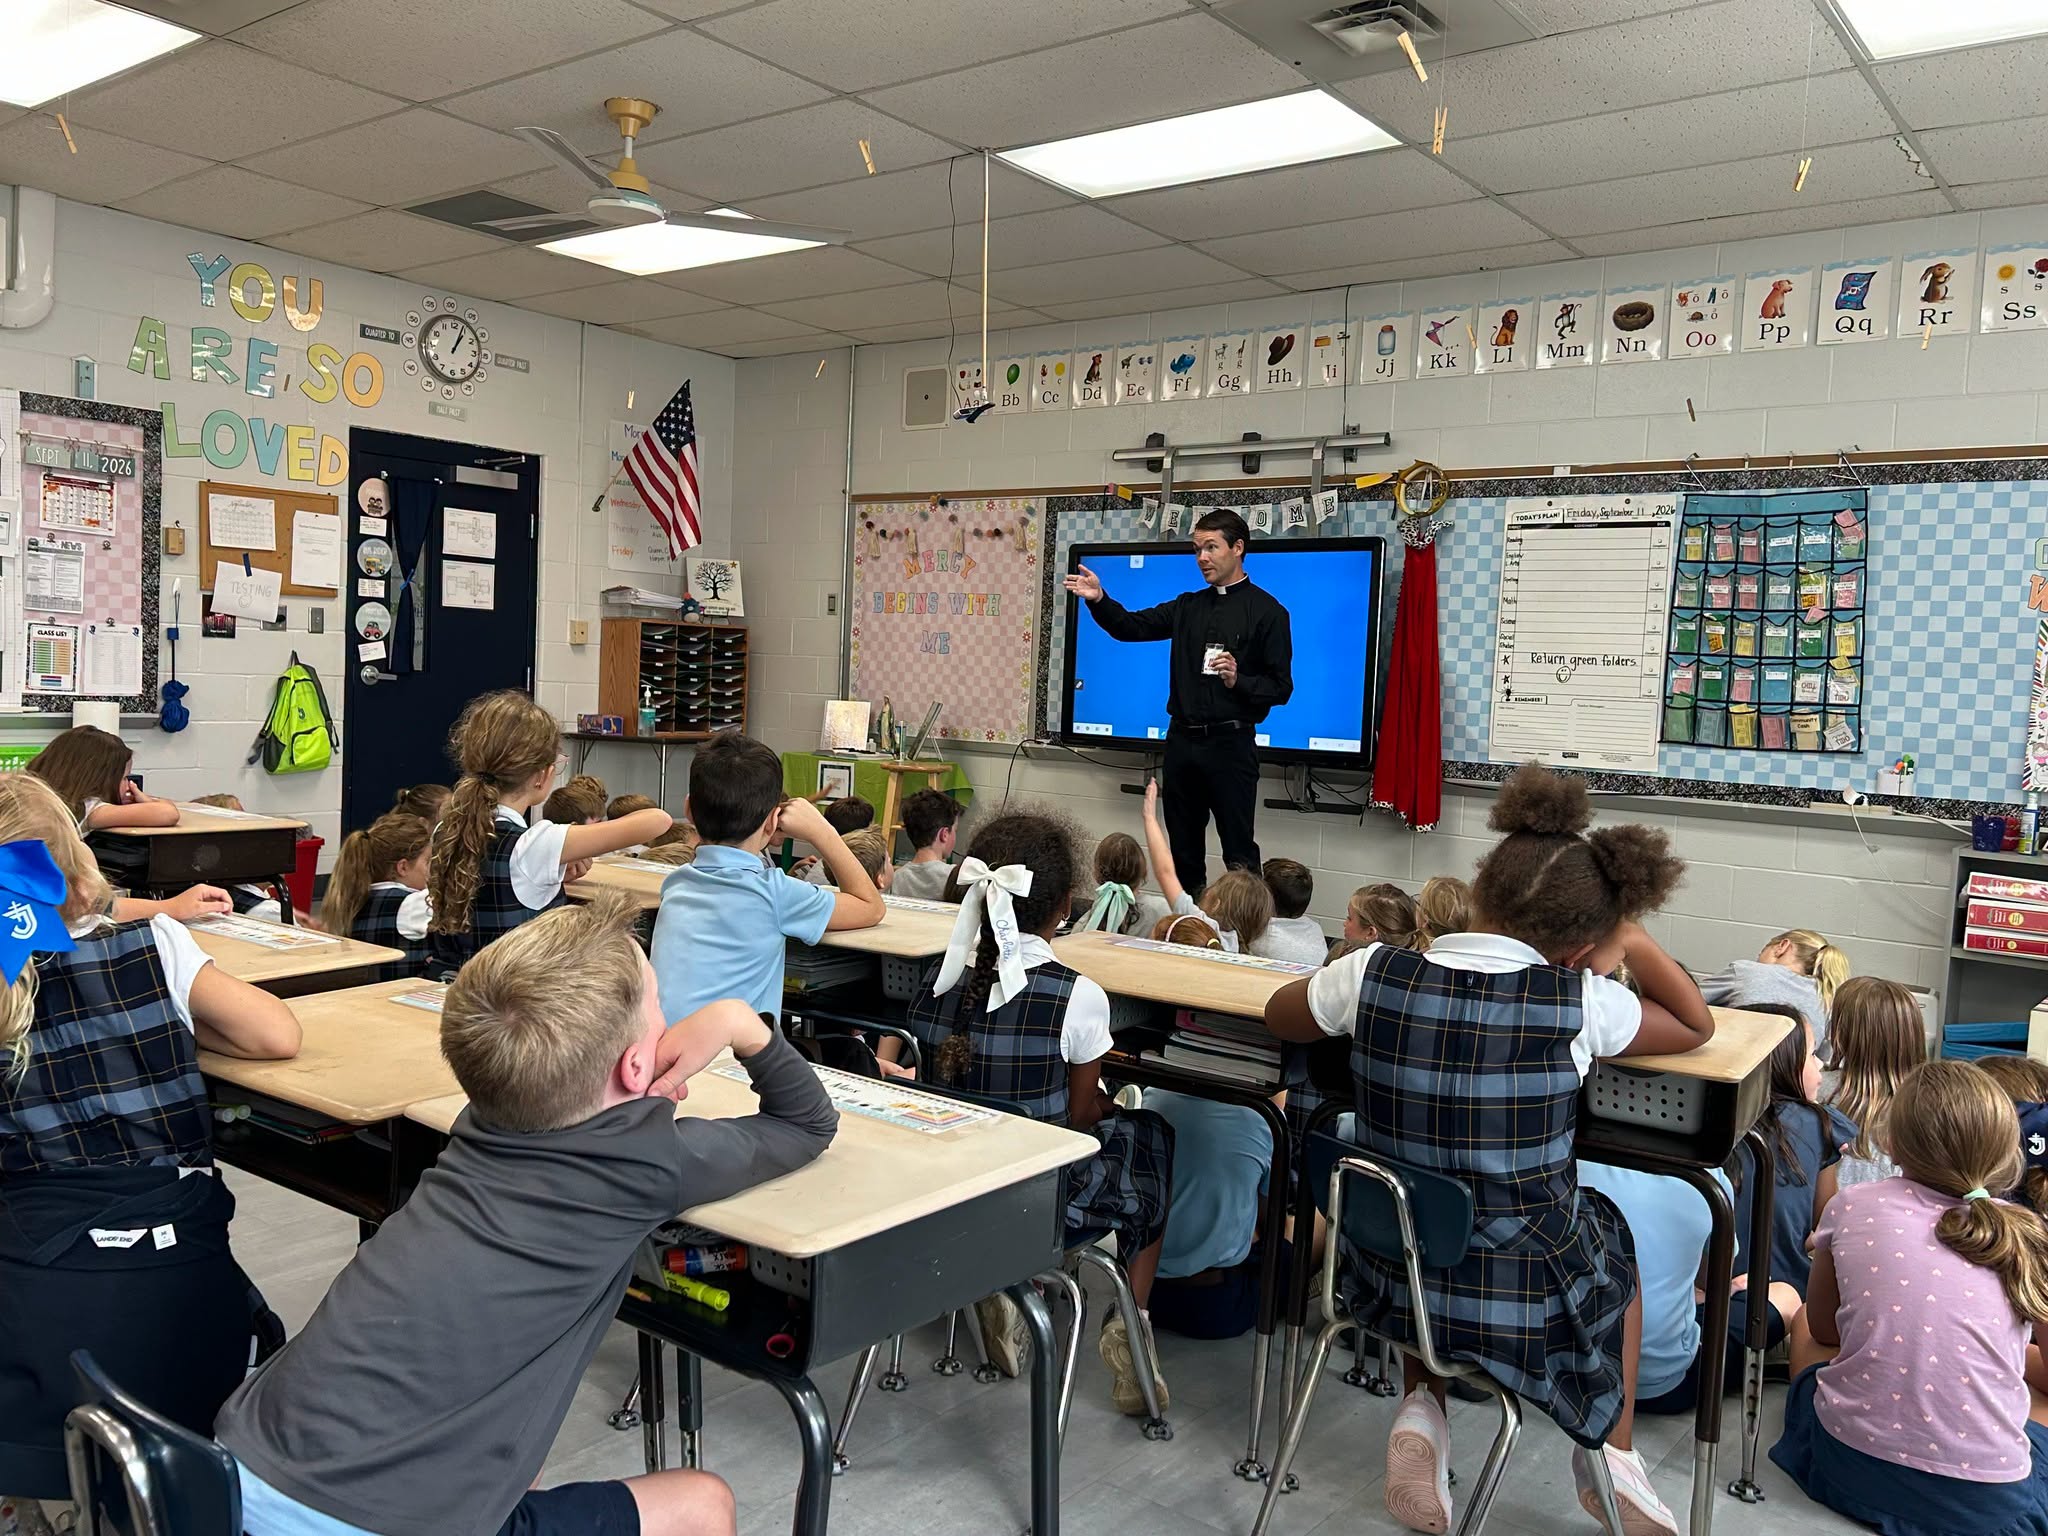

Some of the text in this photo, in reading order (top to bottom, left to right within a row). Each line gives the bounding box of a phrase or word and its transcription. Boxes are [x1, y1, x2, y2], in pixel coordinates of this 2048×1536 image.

[187, 251, 324, 332] YOU
[1918, 308, 1953, 326] Rr
[2003, 302, 2037, 321] Ss
[433, 330, 440, 338] 10
[451, 322, 459, 330] 12
[1759, 323, 1791, 344] Pp
[1835, 316, 1874, 335] Qq
[1616, 337, 1647, 353] Nn
[1685, 331, 1717, 348] Oo
[1492, 349, 1513, 364] Ll
[1546, 342, 1585, 360] Mm
[126, 315, 385, 408] ARE SO
[440, 363, 446, 371] 7
[467, 361, 474, 369] 4
[1376, 358, 1395, 378] Jj
[1430, 353, 1457, 370] Kk
[449, 369, 456, 377] 6
[460, 368, 466, 376] 5
[1267, 369, 1292, 384] Hh
[1126, 383, 1145, 397] Ee
[1173, 377, 1192, 392] Ff
[1218, 374, 1241, 391] Gg
[964, 397, 980, 408] Aa
[1001, 394, 1020, 407] Bb
[1042, 391, 1060, 404] Cc
[1082, 387, 1102, 401] Dd
[160, 401, 350, 487] LOVED
[35, 446, 60, 465] SEPT
[101, 456, 132, 476] 2026
[1144, 496, 1335, 528] WEOME
[1567, 507, 1600, 519] Friday,
[1600, 507, 1634, 519] September
[1637, 507, 1645, 516] 11
[60, 540, 83, 551] NEWS
[611, 546, 634, 559] Friday
[903, 550, 977, 579] MERCY
[231, 581, 273, 598] TESTING
[873, 592, 1001, 616] BEGINS WITH
[920, 630, 950, 654] ME
[1531, 653, 1565, 666] Return
[1570, 656, 1598, 671] green
